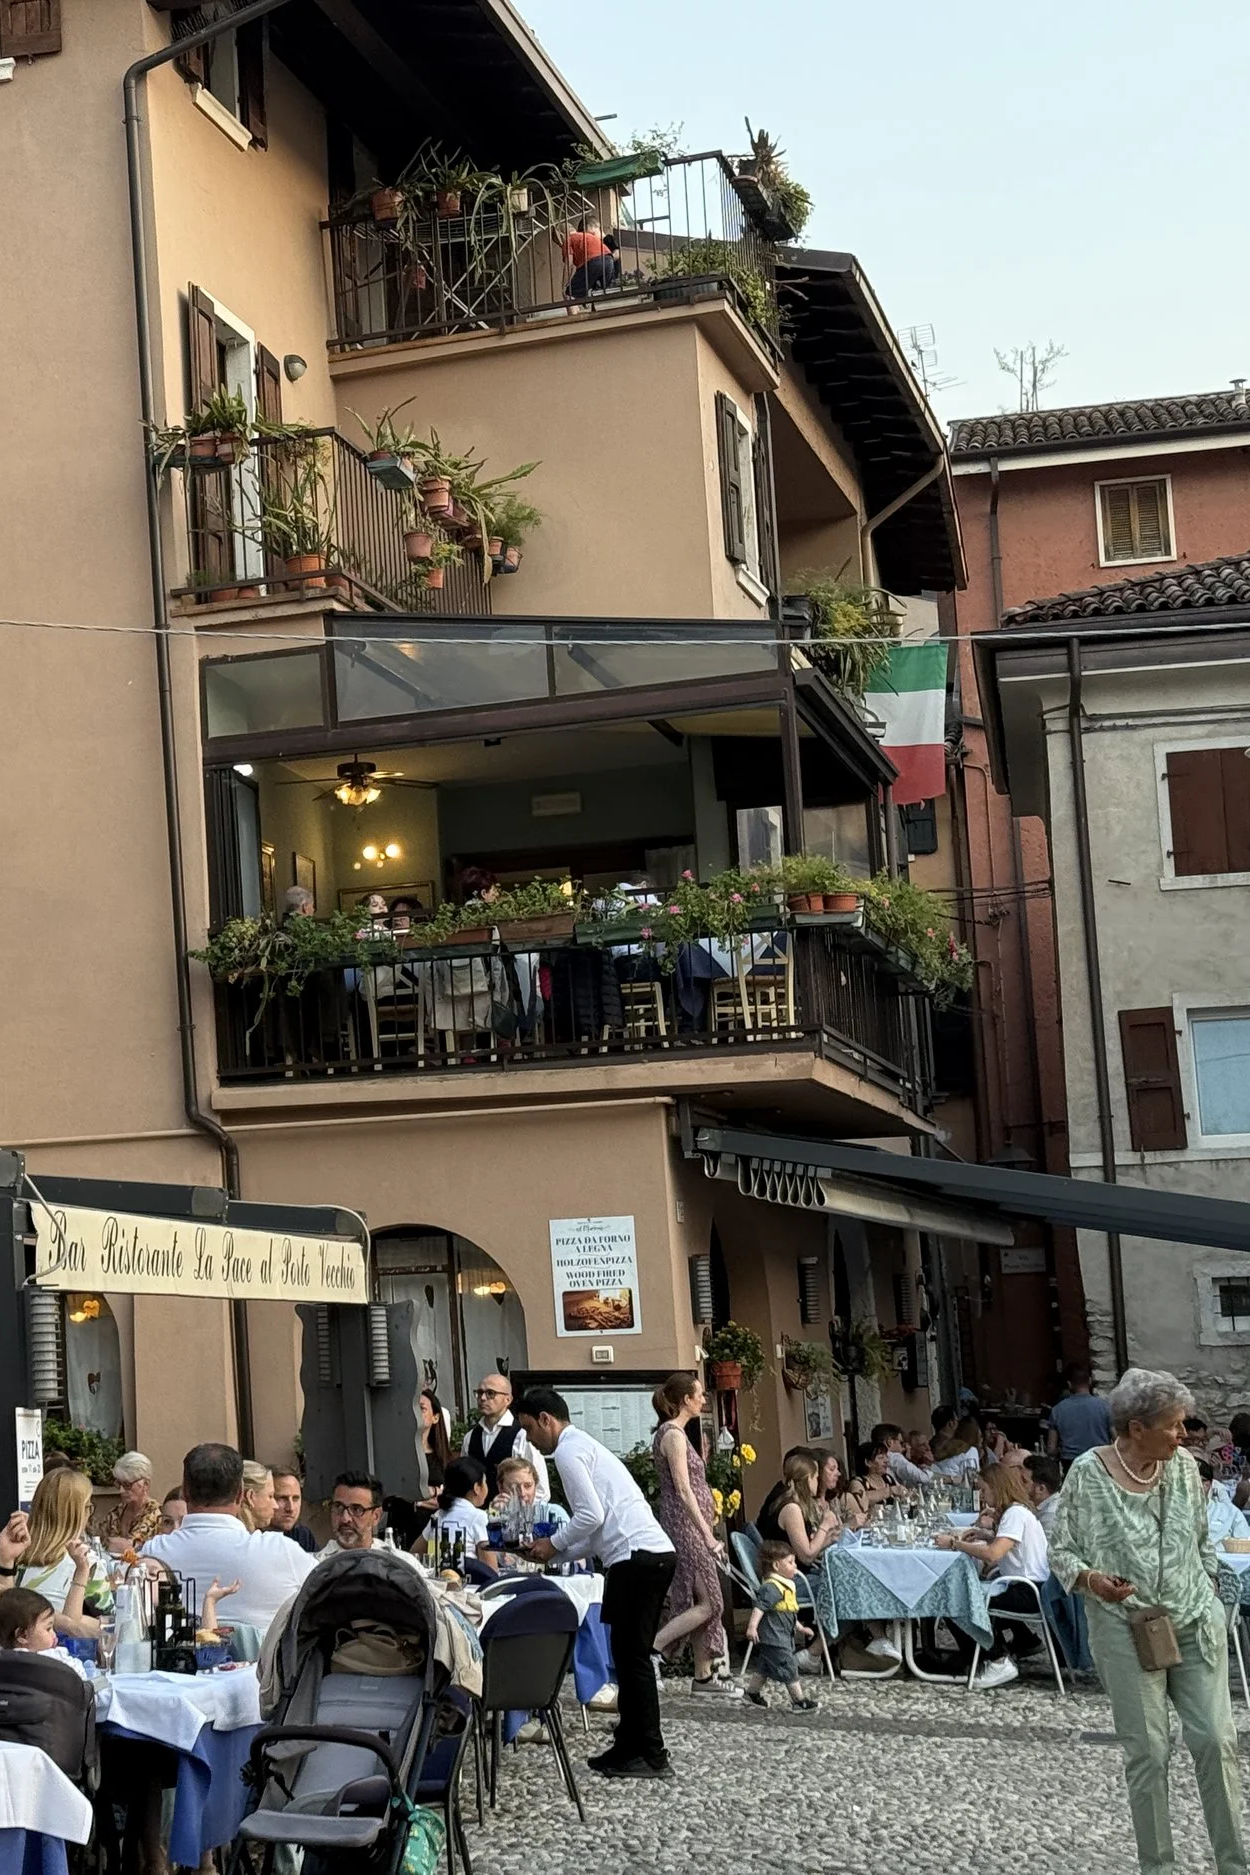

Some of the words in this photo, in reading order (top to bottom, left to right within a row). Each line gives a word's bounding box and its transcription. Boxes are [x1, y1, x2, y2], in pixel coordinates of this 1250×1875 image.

[555, 1236, 582, 1246] PIZZA
[584, 1235, 599, 1245] DA
[599, 1234, 631, 1244] FORNO
[49, 1210, 87, 1272] Bar
[101, 1216, 183, 1278] Ristorante
[193, 1227, 213, 1281] La
[221, 1231, 252, 1284] Pace
[260, 1238, 275, 1285] al
[281, 1238, 310, 1287] Porto
[319, 1242, 356, 1290] Vecchio
[583, 1244, 613, 1253] LEGNA
[556, 1255, 633, 1268] HOLZOFENPIZZA
[566, 1270, 595, 1280] WOOD
[597, 1269, 625, 1279] FIRED
[569, 1279, 595, 1288] OVEN
[596, 1277, 623, 1287] PIZZA
[21, 1440, 40, 1460] PIZZA
